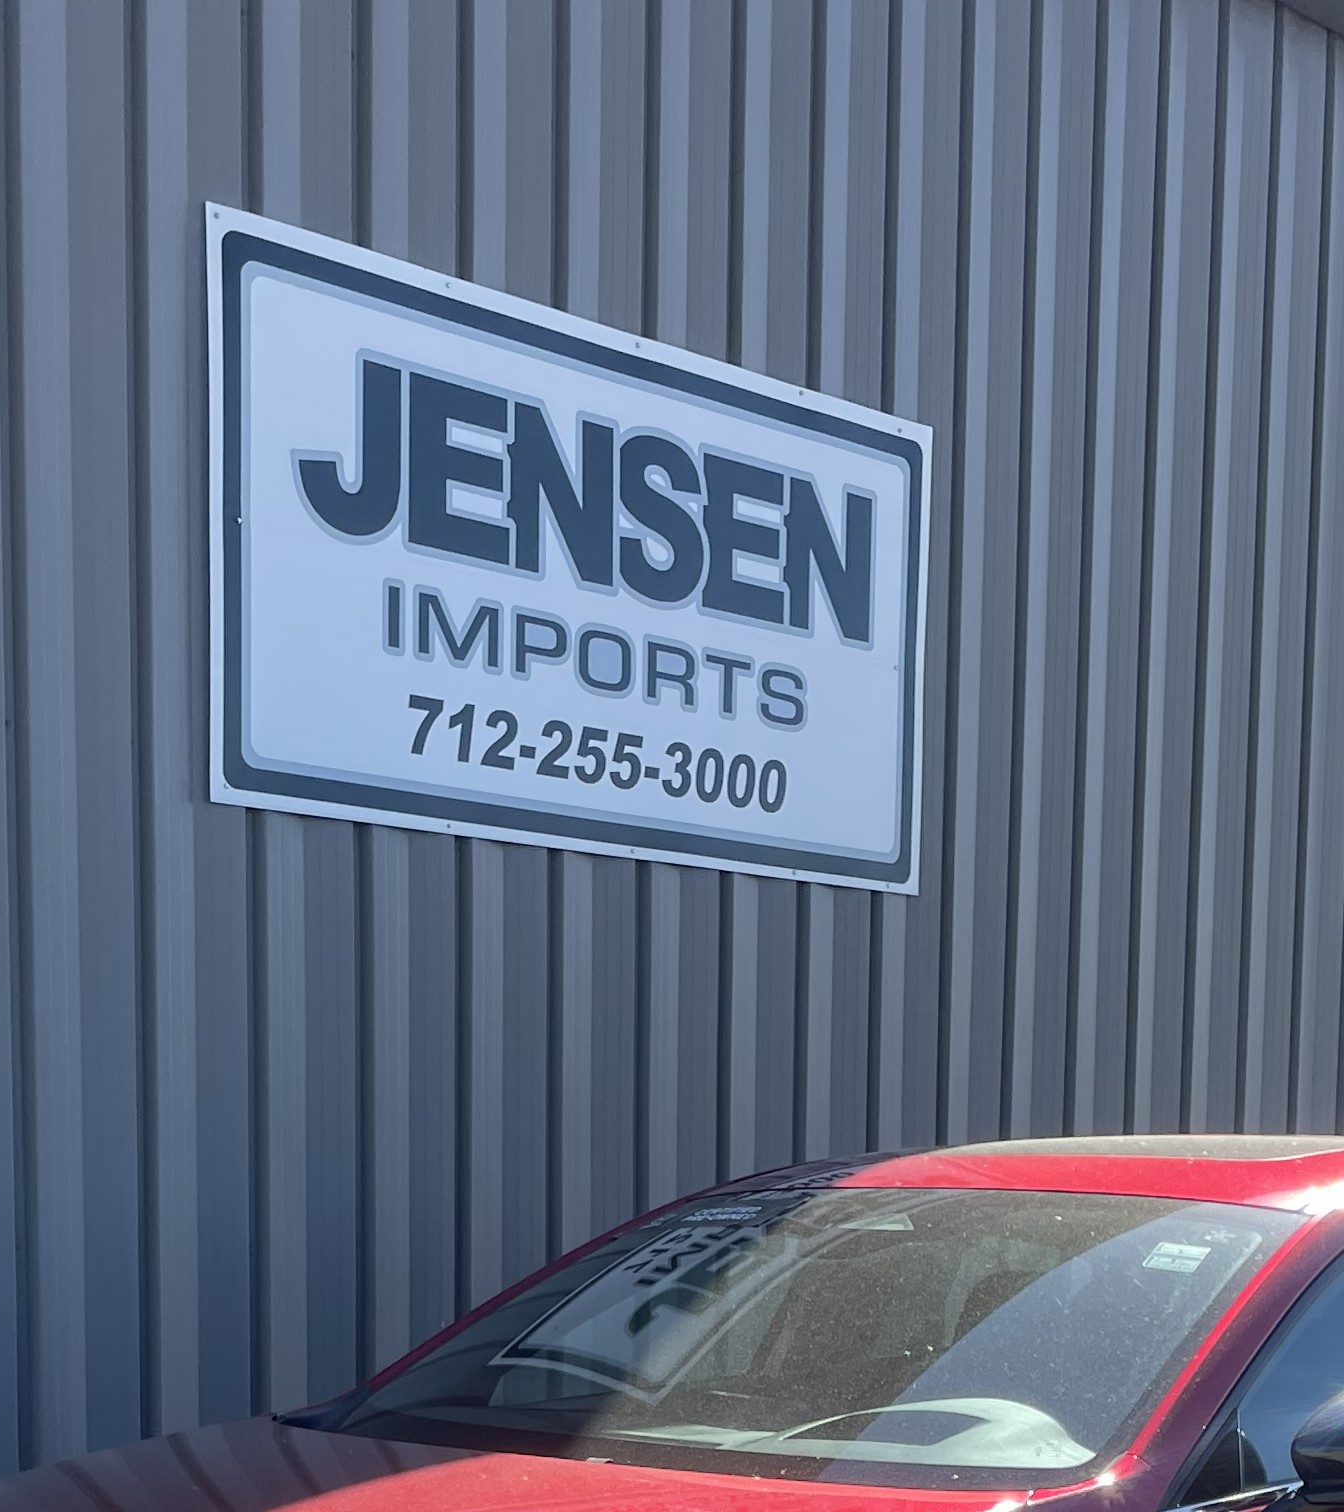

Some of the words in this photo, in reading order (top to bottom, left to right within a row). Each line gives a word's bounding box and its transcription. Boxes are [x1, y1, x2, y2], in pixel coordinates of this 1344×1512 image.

[293, 352, 875, 647] JENSEN
[385, 580, 807, 729] IMPORTS
[407, 693, 788, 814] 712-255-3000
